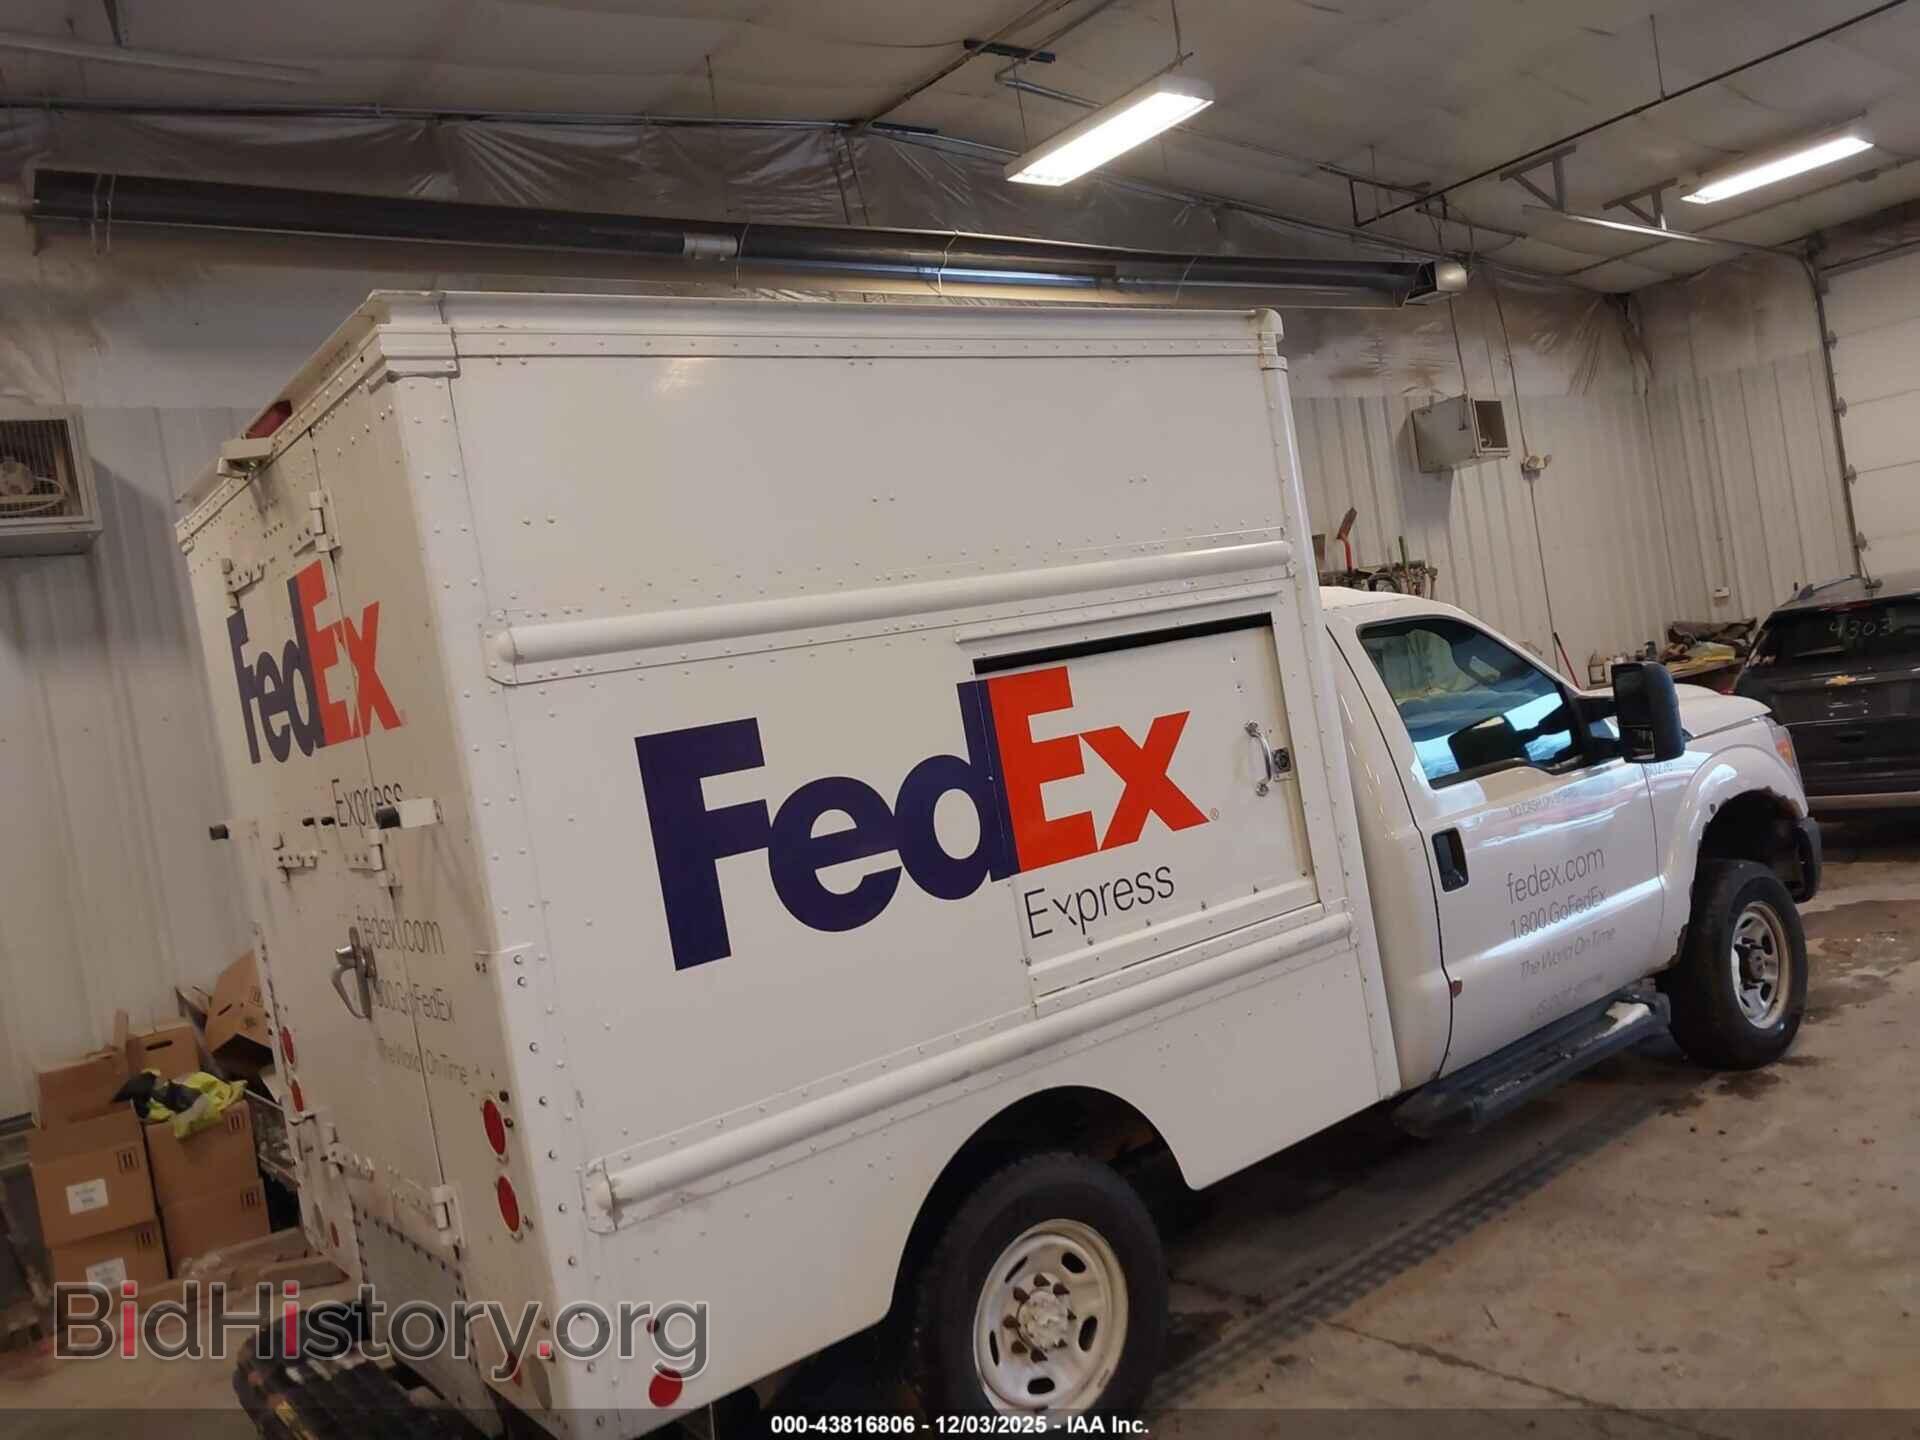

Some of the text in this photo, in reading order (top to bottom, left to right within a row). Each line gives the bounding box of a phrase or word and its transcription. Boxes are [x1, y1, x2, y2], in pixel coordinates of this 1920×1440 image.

[226, 559, 402, 764] FedEx
[1828, 616, 1894, 640] 4303
[331, 777, 403, 838] Express
[634, 665, 1211, 971] FedEx
[1024, 866, 1175, 939] Express
[1506, 848, 1606, 904] fedex.com
